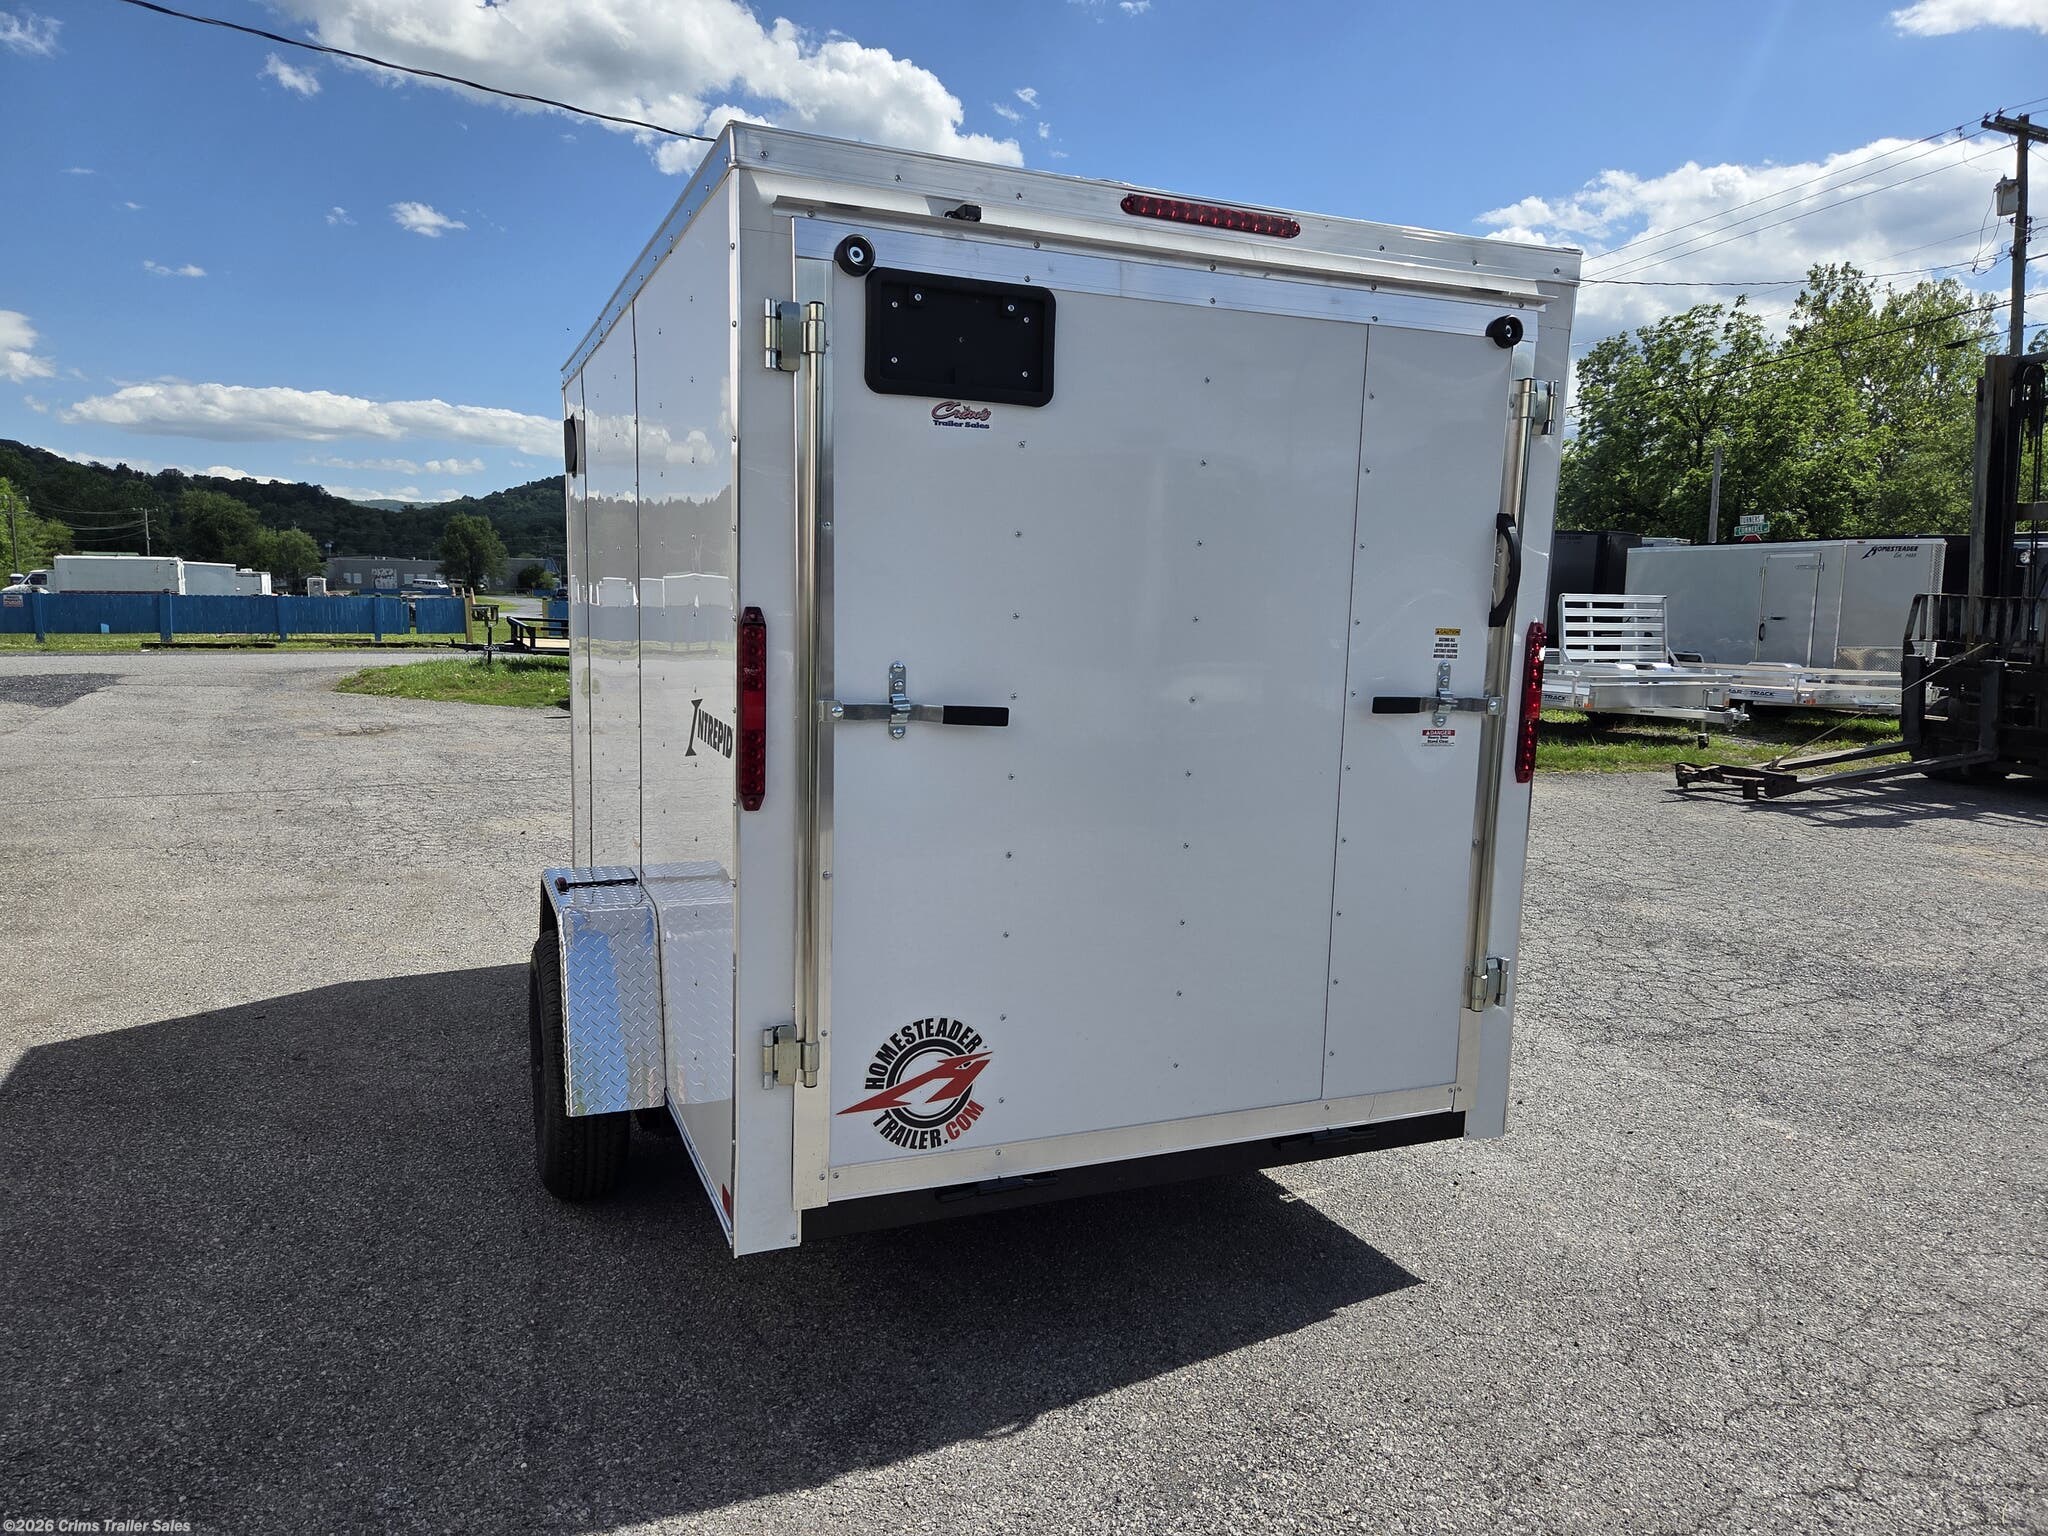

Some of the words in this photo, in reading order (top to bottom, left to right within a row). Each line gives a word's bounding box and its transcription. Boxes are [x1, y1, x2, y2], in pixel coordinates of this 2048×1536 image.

[933, 420, 964, 428] Trailer
[965, 421, 990, 429] Sales
[1861, 545, 1919, 560] HOMESTEADER
[685, 698, 733, 759] INTREPID
[865, 1017, 983, 1090] HOMESTEADER
[873, 1099, 985, 1150] TRAILER.COM
